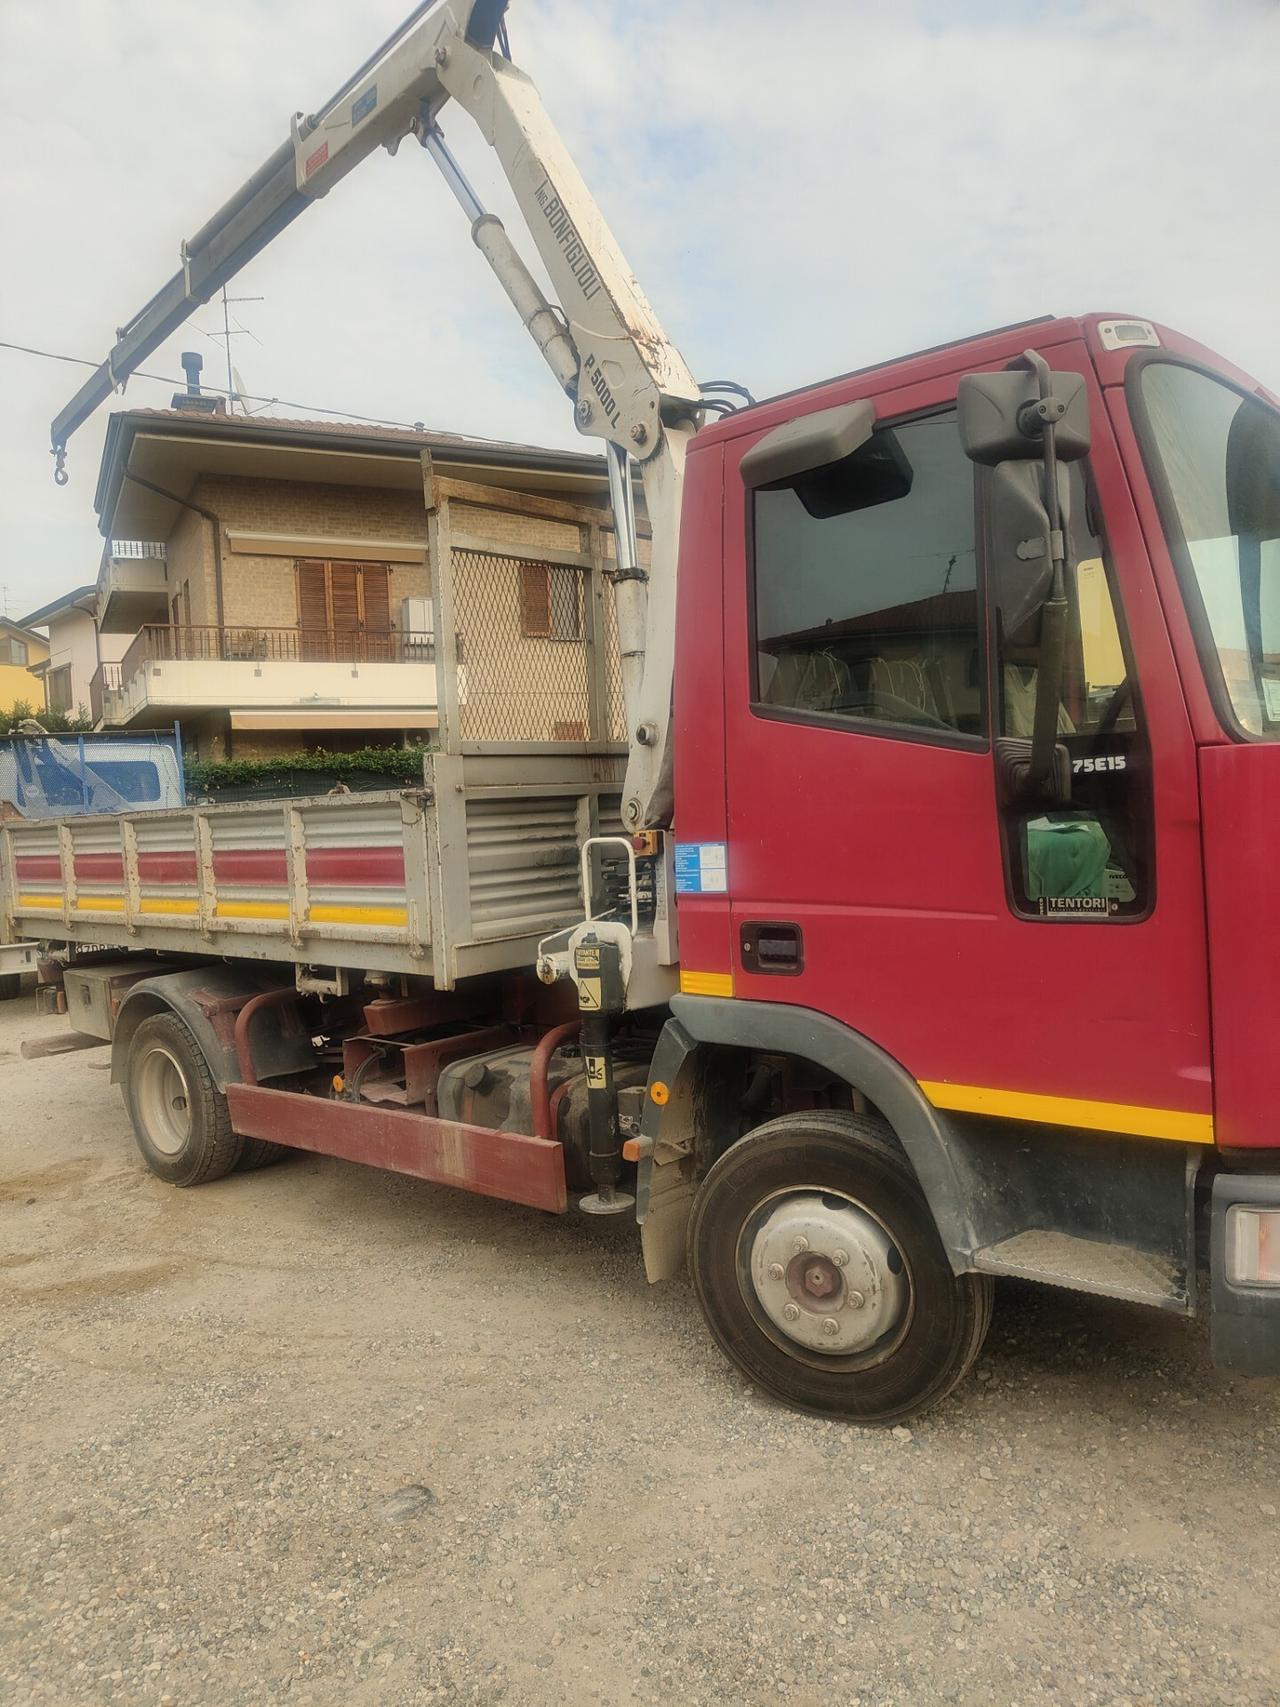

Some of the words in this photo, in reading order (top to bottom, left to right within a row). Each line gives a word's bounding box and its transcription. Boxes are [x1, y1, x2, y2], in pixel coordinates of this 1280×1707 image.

[543, 197, 602, 301] BONFIGLIOLI
[591, 367, 616, 417] 5000
[610, 411, 621, 429] L
[1072, 755, 1127, 773] 75E15
[1049, 897, 1106, 908] TENTORI
